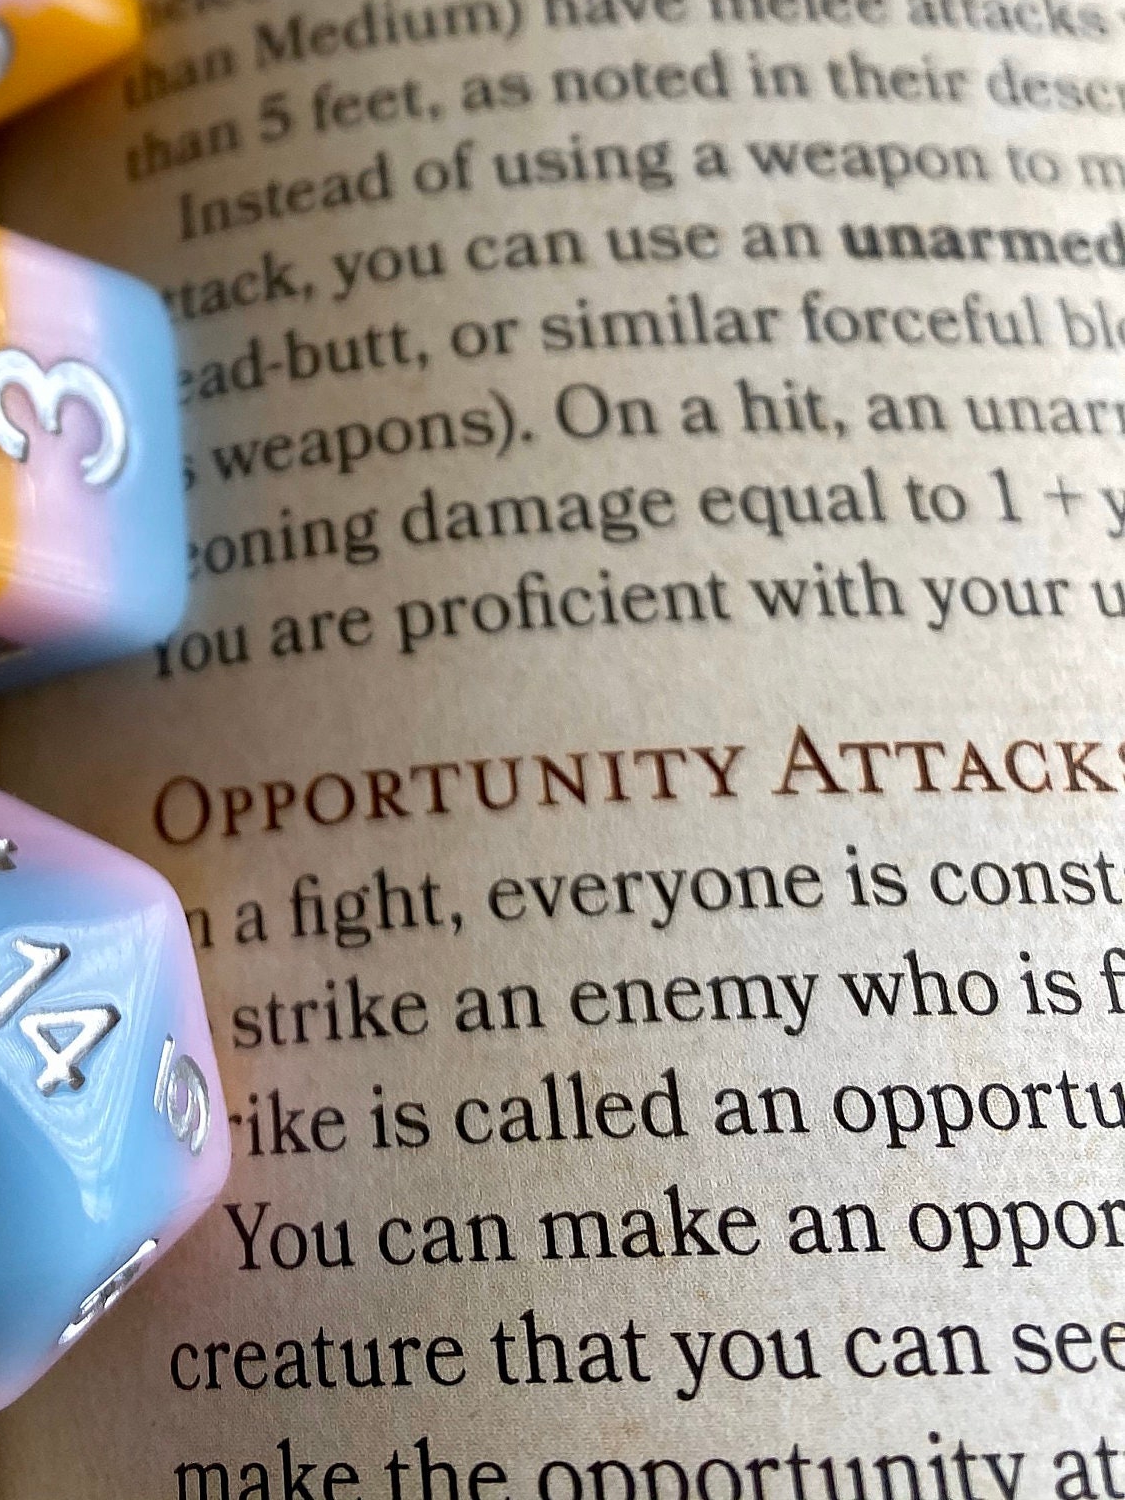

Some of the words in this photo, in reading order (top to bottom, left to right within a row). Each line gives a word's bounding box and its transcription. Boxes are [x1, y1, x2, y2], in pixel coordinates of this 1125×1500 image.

[123, 118, 240, 184] than
[260, 93, 292, 145] 5
[311, 78, 441, 134] feet,
[462, 71, 531, 114] as
[552, 48, 731, 102] noted
[748, 48, 810, 98] in
[828, 48, 968, 104] their
[124, 44, 236, 111] than
[179, 149, 392, 242] Instead
[414, 136, 477, 196] of
[493, 134, 675, 193] using
[747, 139, 990, 193] weapon
[1006, 143, 1061, 187] to
[333, 237, 447, 300] you
[466, 224, 586, 273] can
[605, 220, 719, 264] use
[742, 220, 821, 260] an
[841, 220, 1125, 269] unarmed
[178, 321, 430, 405] ead-butt,
[451, 316, 518, 359] or
[541, 283, 779, 352] similar
[802, 279, 1041, 348] forceful
[213, 388, 533, 484] weapons).
[555, 383, 657, 439] On
[736, 376, 848, 438] hit,
[868, 394, 945, 431] an
[402, 485, 676, 546] damage
[700, 465, 885, 539] equal
[904, 474, 967, 523] to
[990, 467, 1022, 523] 1
[270, 605, 373, 657] are
[395, 570, 731, 654] proficient
[749, 558, 905, 619] with
[922, 575, 1068, 631] your
[153, 743, 746, 845] OPPORTUNITY
[772, 724, 1125, 795] ATTACK
[290, 867, 464, 949] fight,
[488, 863, 823, 930] everyone
[846, 844, 908, 908] is
[232, 975, 430, 1050] strike
[455, 983, 545, 1034] an
[570, 971, 819, 1036] enemy
[839, 948, 1000, 1017] who
[1019, 951, 1083, 1016] is
[372, 1084, 431, 1149] is
[455, 1067, 689, 1145] called
[715, 1087, 809, 1135] an
[224, 1203, 356, 1271] You
[378, 1211, 516, 1267] can
[538, 1184, 761, 1261] make
[788, 1203, 885, 1255] an
[170, 1326, 467, 1390] creature
[490, 1309, 651, 1386] that
[670, 1328, 821, 1402] you
[845, 1323, 991, 1380] can
[1012, 1320, 1125, 1376] see
[174, 1438, 360, 1500] make
[384, 1438, 508, 1500] the
[538, 1430, 1025, 1500] opportunity
